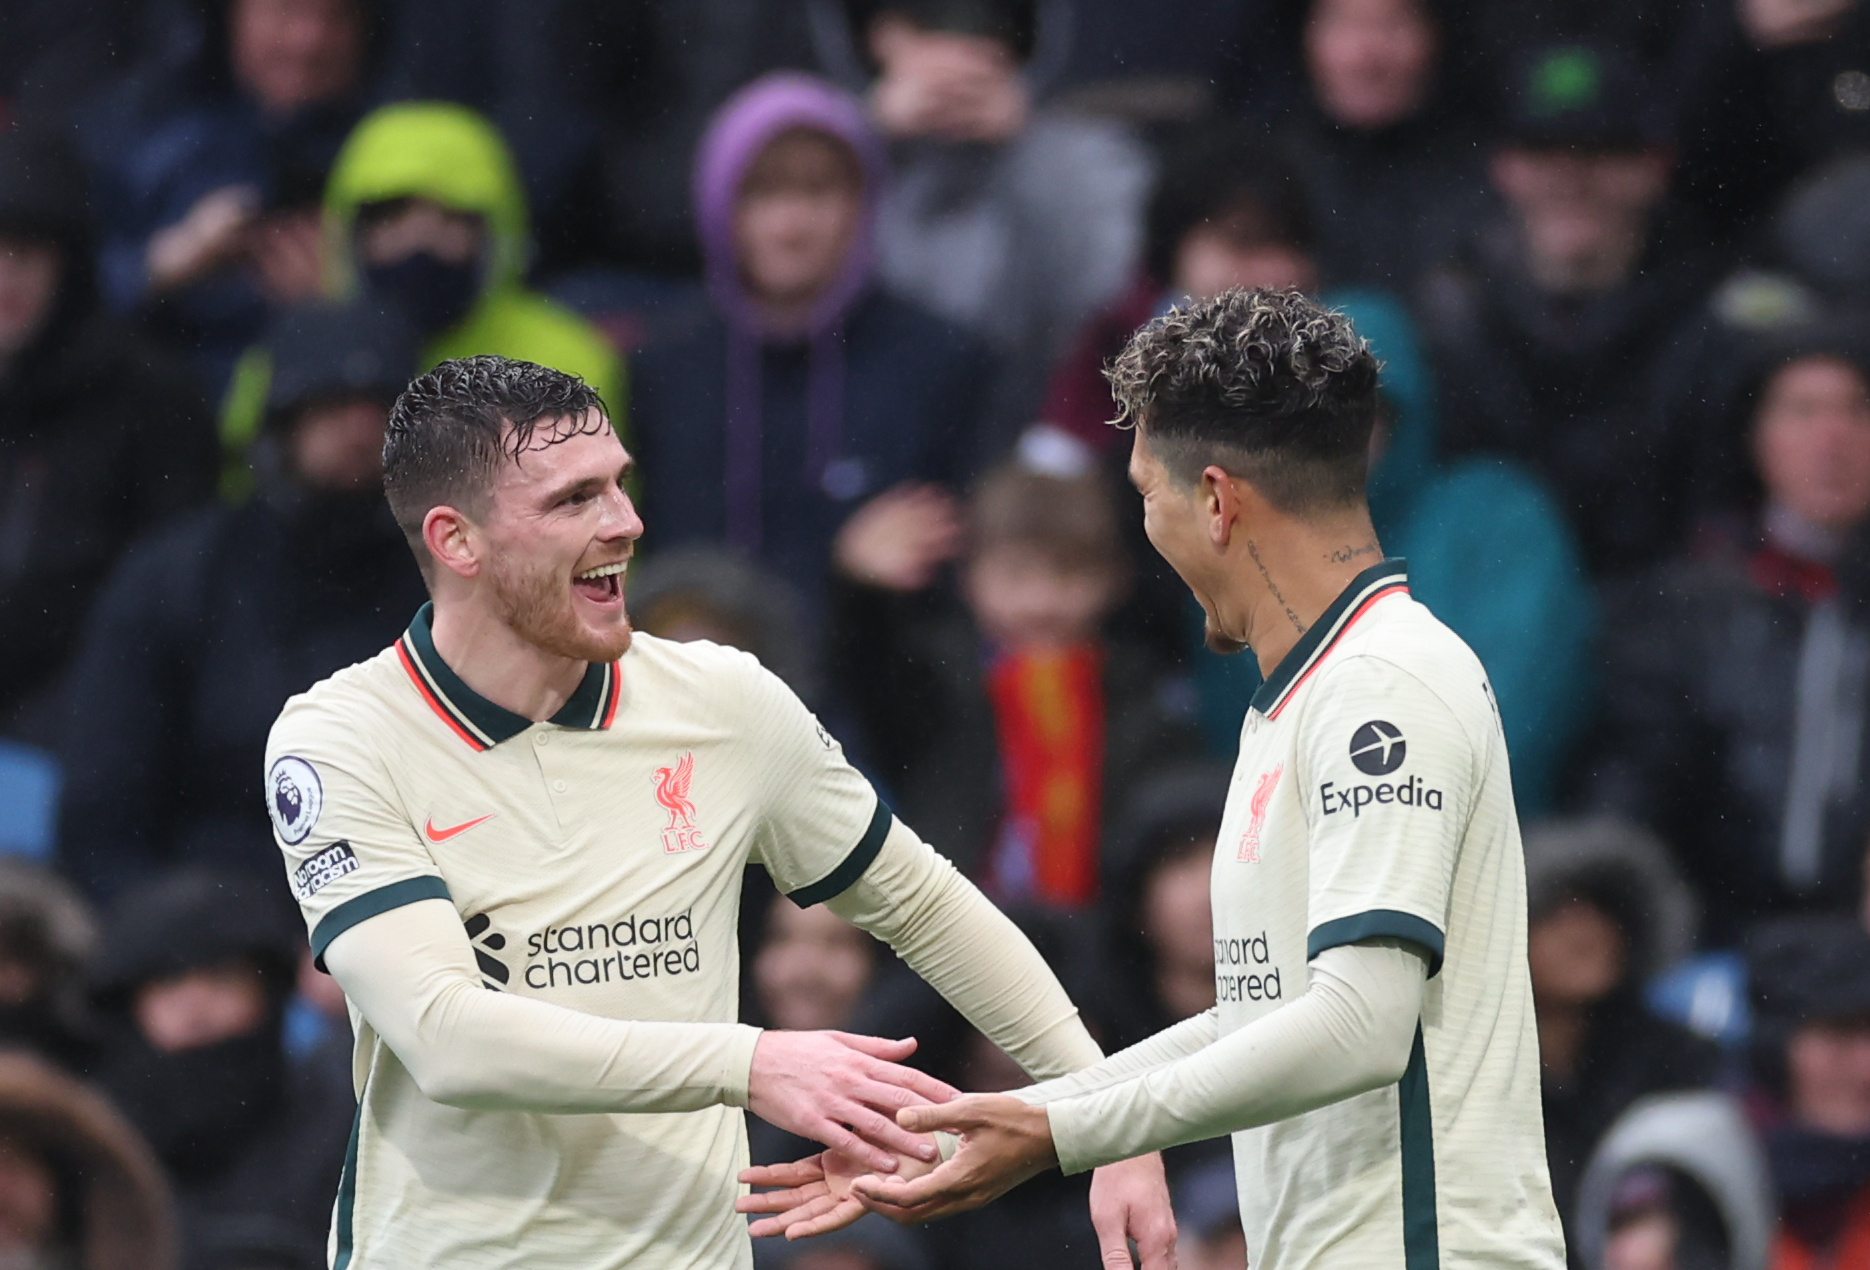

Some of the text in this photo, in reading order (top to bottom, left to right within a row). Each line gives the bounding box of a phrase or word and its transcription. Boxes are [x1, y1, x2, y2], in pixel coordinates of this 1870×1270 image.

[1320, 774, 1443, 818] Expedia
[306, 845, 347, 878] room
[310, 855, 360, 894] racism
[527, 907, 694, 957] standard
[525, 939, 700, 989] chartered
